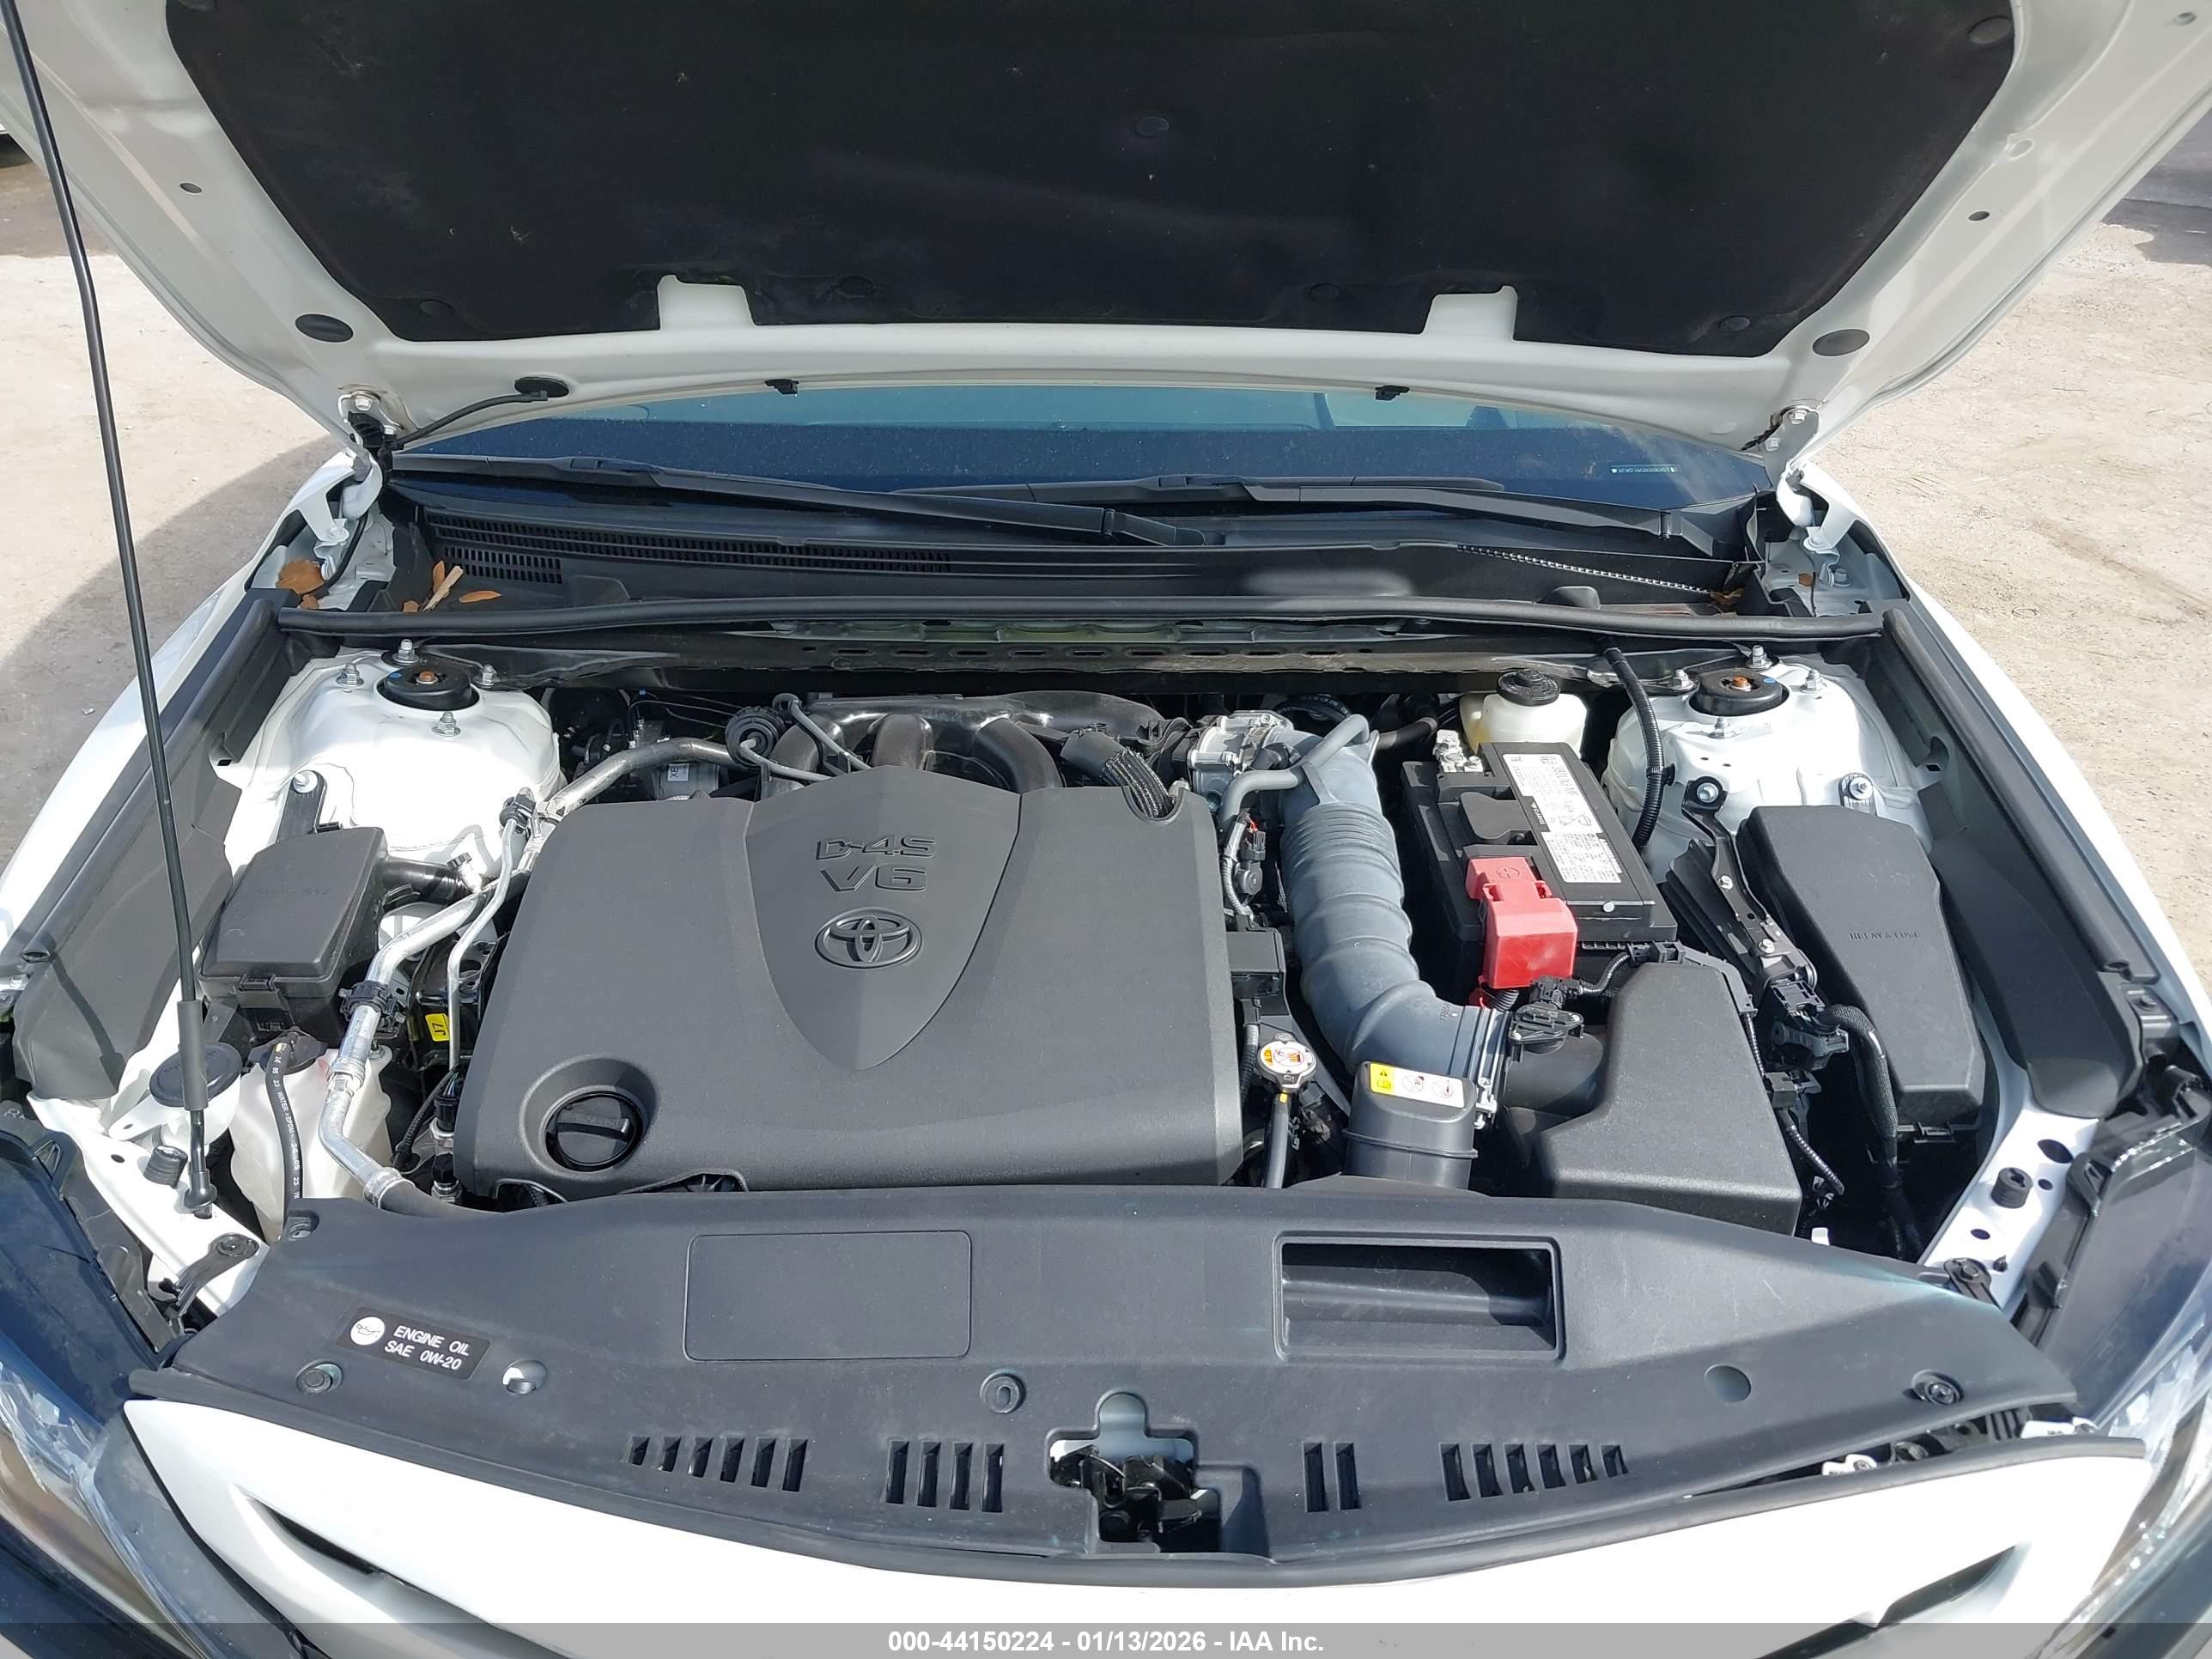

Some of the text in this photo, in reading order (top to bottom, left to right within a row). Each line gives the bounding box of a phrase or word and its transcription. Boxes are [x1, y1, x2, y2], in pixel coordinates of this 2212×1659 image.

[671, 767, 678, 778] XE
[816, 835, 935, 860] D-4S
[820, 864, 927, 892] V6
[433, 1023, 446, 1036] J7
[277, 1091, 289, 1112] WATER
[293, 1176, 300, 1186] 23
[393, 1325, 470, 1356] ENGINE OIL
[384, 1340, 462, 1370] SAE 0W-20
